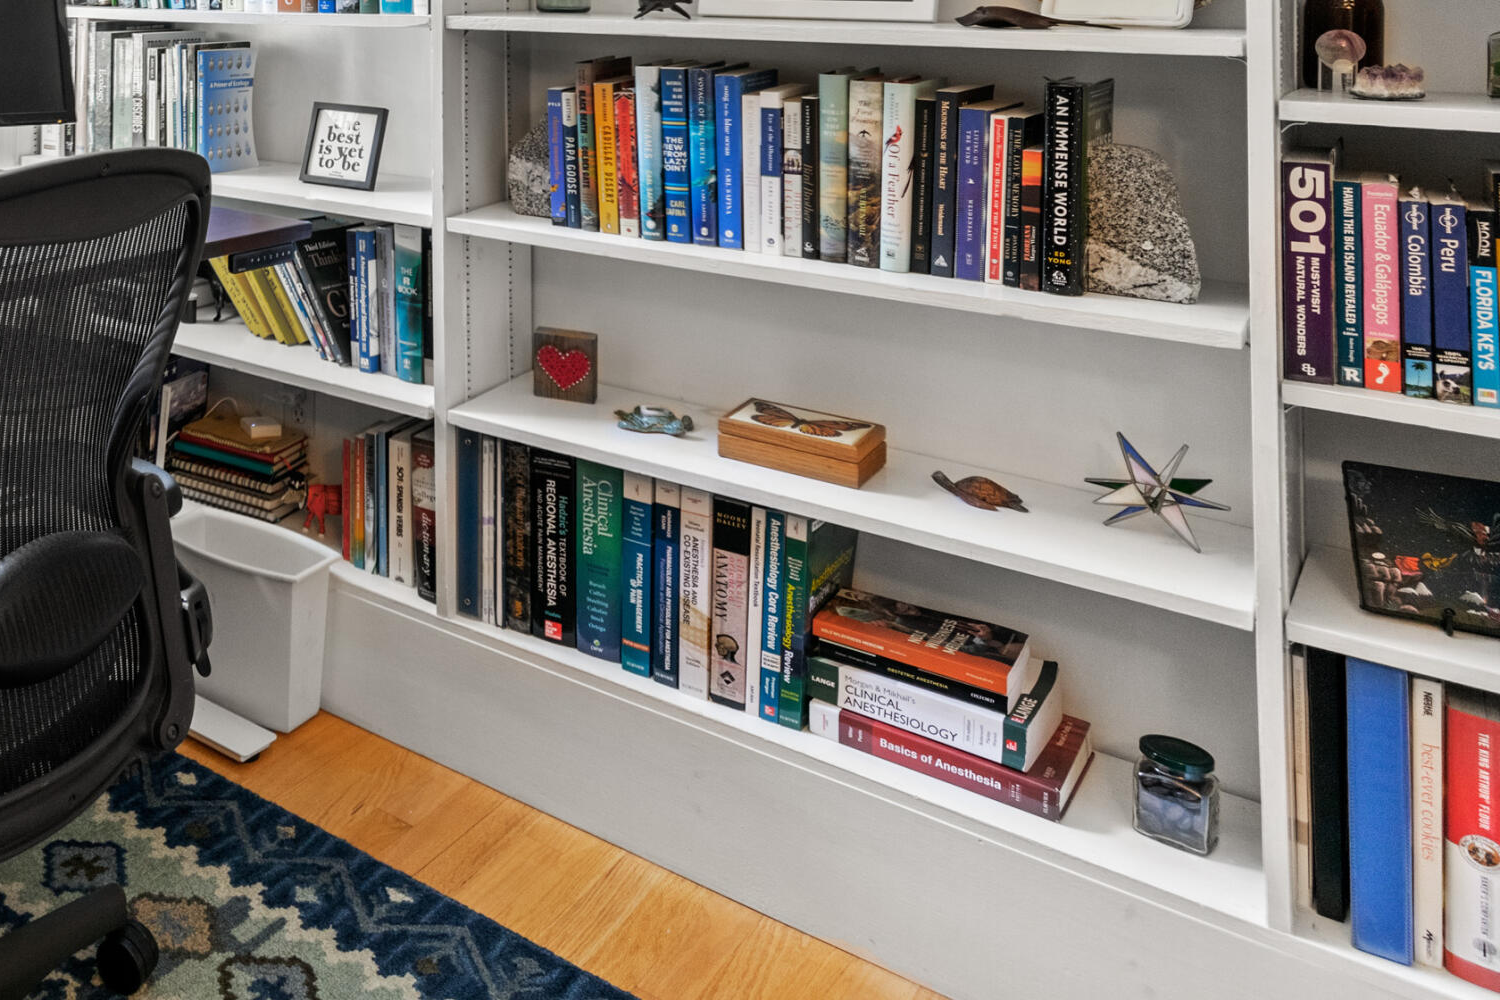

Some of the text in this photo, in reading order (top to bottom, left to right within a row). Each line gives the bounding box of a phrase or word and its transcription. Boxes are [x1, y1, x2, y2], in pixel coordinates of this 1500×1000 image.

[96, 69, 107, 104] Ecology
[318, 139, 364, 161] is yet
[318, 154, 361, 172] to be
[327, 125, 361, 145] best
[888, 144, 900, 160] Of
[565, 136, 577, 195] PAPA GOOSE
[603, 126, 614, 204] CADILLAC DESERT
[1053, 95, 1068, 245] AN IMMENSE WORLD
[886, 174, 900, 218] Feather
[1010, 183, 1020, 218] MEMORY
[1288, 166, 1326, 254] 501
[1342, 186, 1356, 324] HAWAII THE BIG ISLAND REVEALED
[1371, 204, 1392, 325] Ecuador & Galápagos
[1407, 234, 1426, 296] Colombia
[1439, 238, 1459, 272] Peru
[1478, 221, 1490, 256] MOON
[1296, 256, 1306, 356] NATURAL WONDERS
[1310, 256, 1320, 314] MUST-VISIT
[1476, 270, 1494, 370] FLORIDA KEYS
[396, 466, 404, 538] 501 SPANISH VERBS
[582, 476, 598, 554] Anesthesia
[596, 480, 612, 538] Clinical
[546, 479, 556, 606] REGIONAL ANESTHESIA
[558, 495, 568, 596] Hadzic's TEXTBOOK OF
[691, 535, 699, 588] ANESTHESIA
[682, 590, 690, 625] DISEASE
[714, 550, 728, 622] ANATOMY
[766, 518, 782, 650] Anesthesiology Core Review
[782, 583, 796, 684] Anesthesiology Review
[811, 675, 836, 688] LANGE
[845, 684, 902, 712] CLINICAL
[844, 696, 958, 742] ANESTHESIOLOGY
[880, 737, 1003, 790] Basics of Anesthesia
[1420, 743, 1440, 861] best-ever cookies
